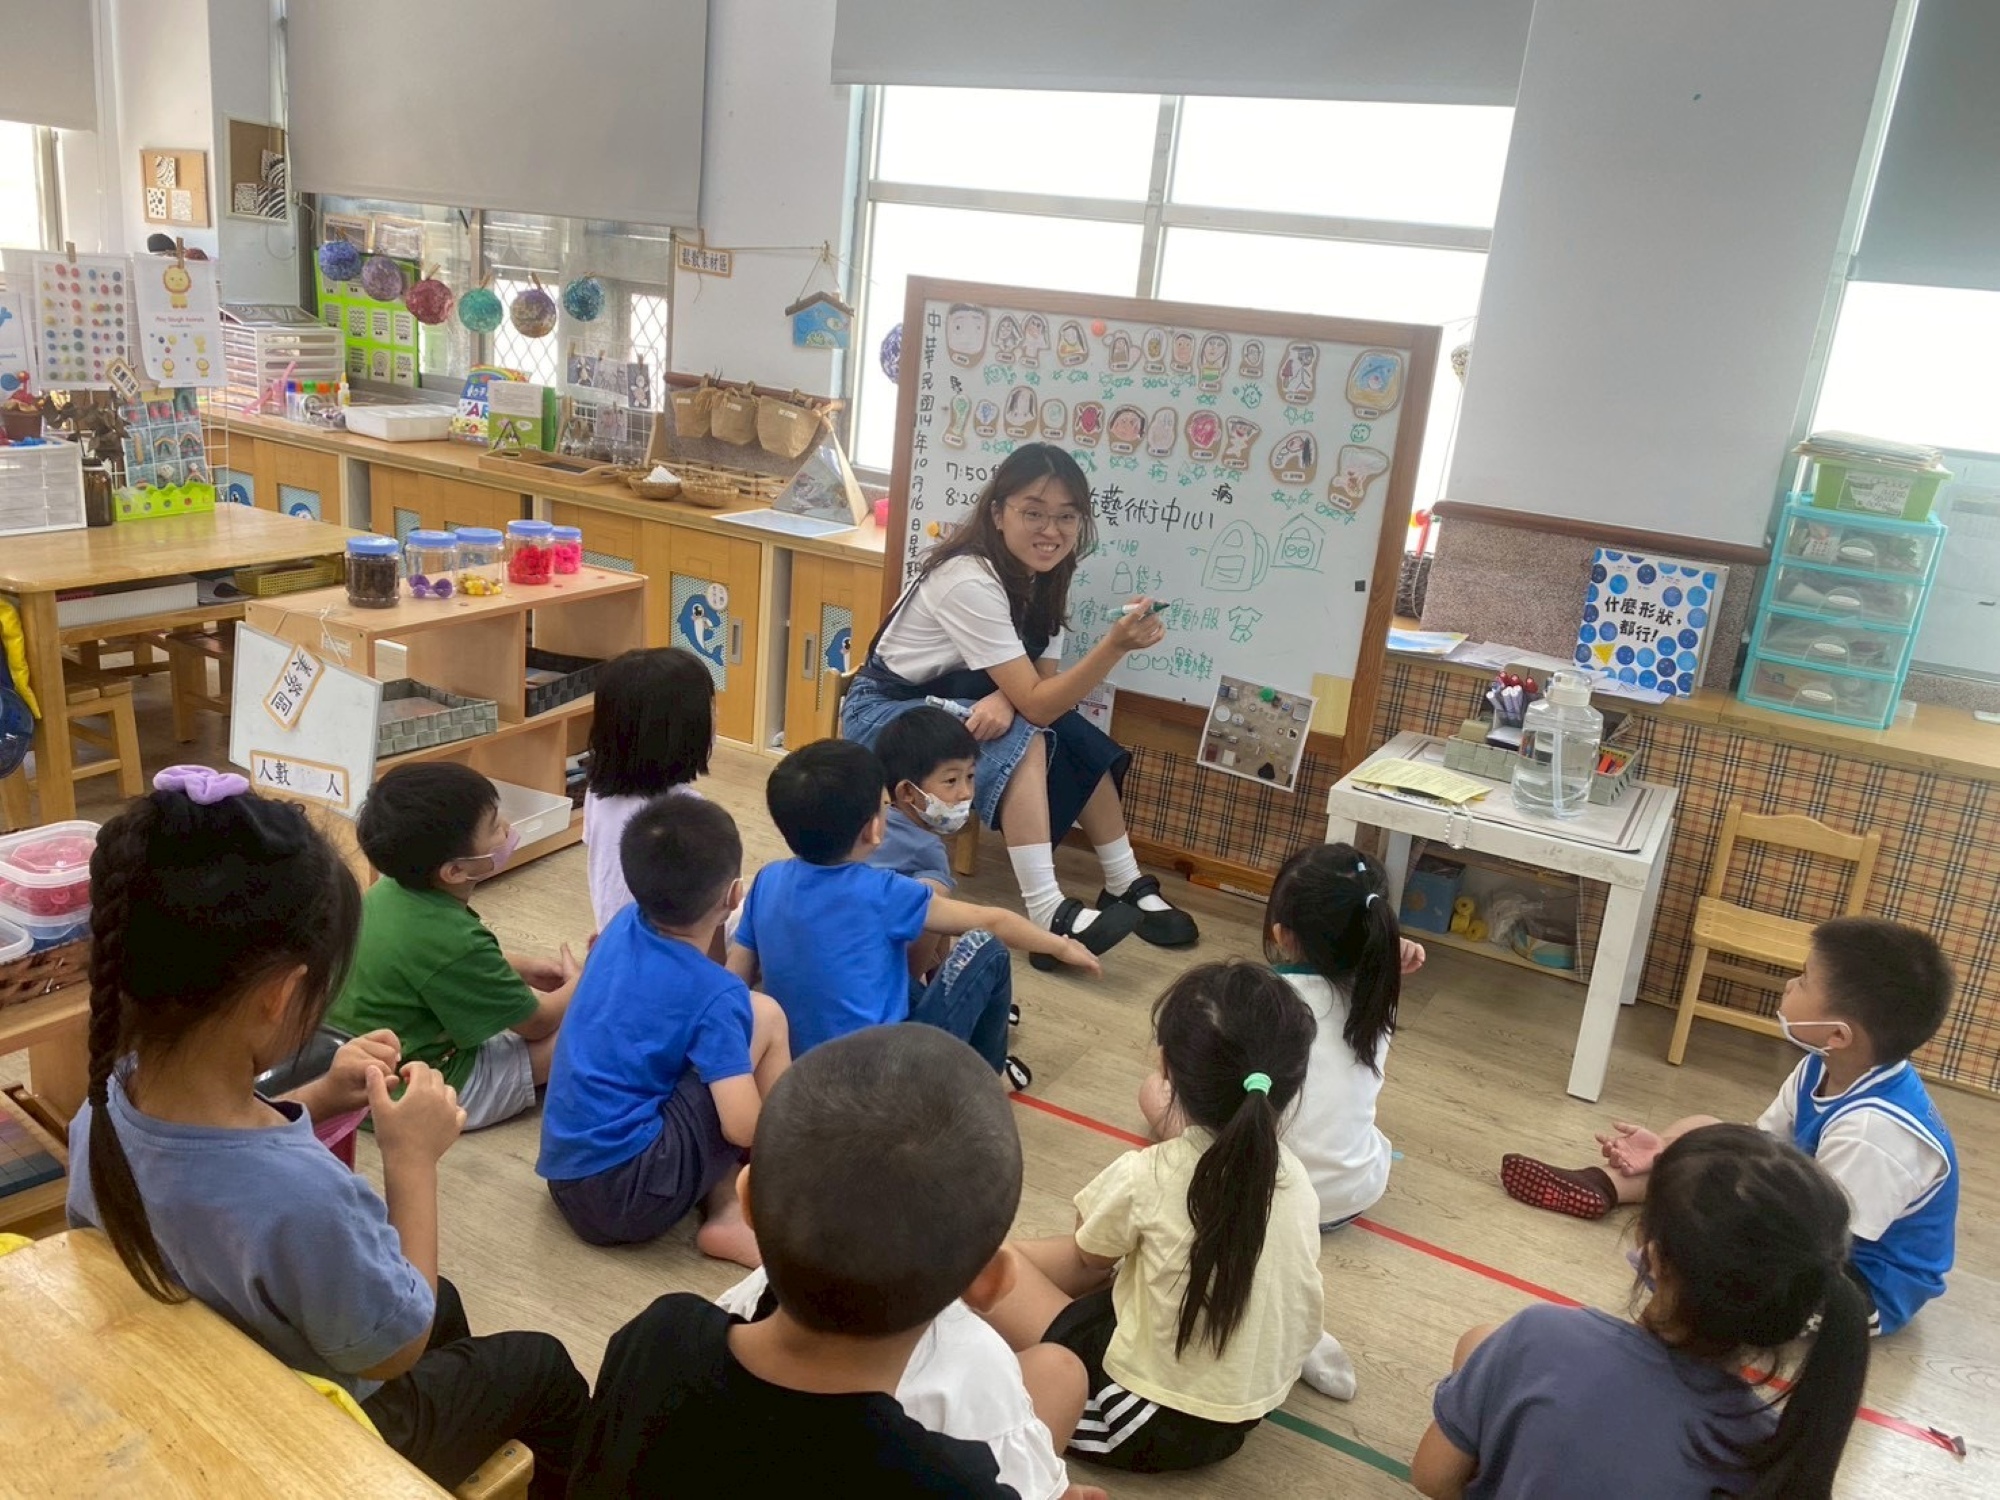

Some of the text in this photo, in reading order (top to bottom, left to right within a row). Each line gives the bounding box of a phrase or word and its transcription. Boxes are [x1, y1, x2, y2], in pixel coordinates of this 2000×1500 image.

[946, 461, 988, 482] 7:50
[945, 486, 980, 507] 8:20
[270, 650, 313, 717] 美勞區
[259, 758, 342, 797] 人數 人
